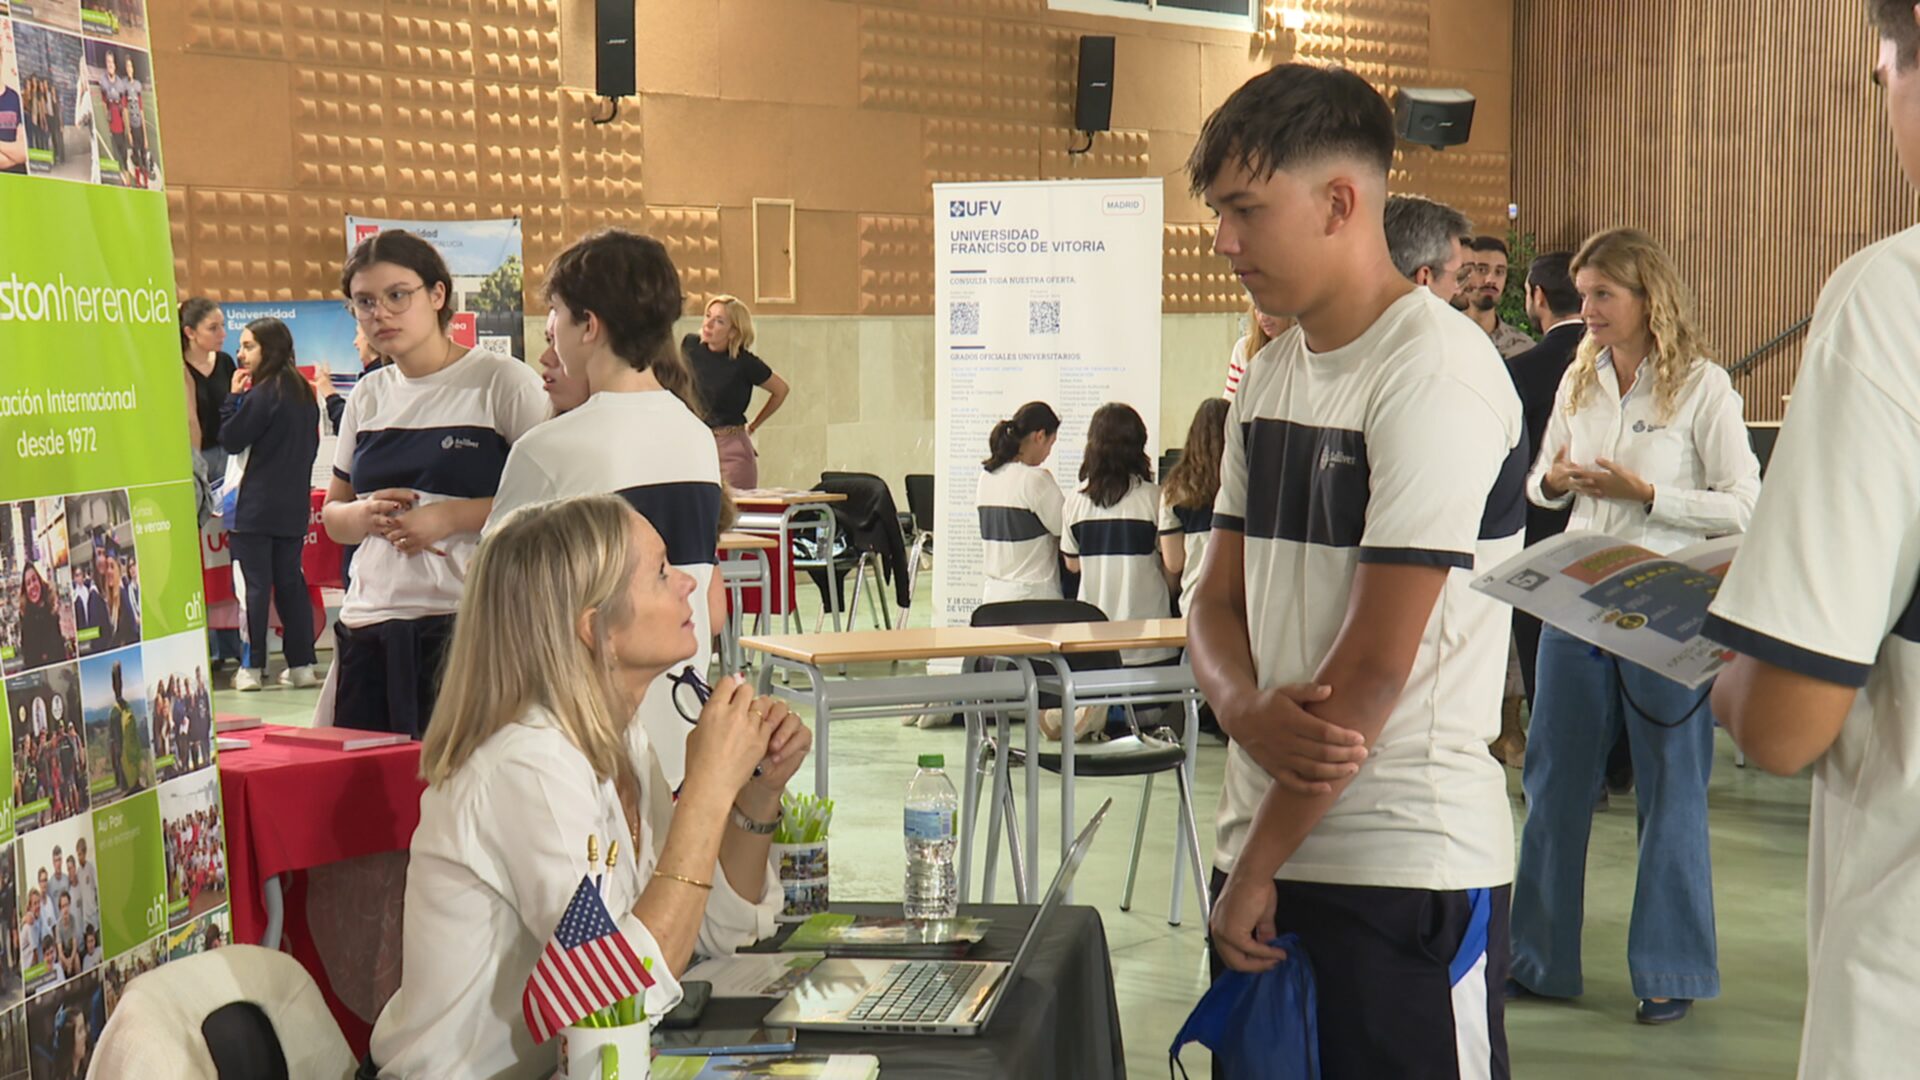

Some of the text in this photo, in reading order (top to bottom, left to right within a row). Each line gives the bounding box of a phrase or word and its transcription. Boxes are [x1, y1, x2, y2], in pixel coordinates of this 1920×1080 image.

[966, 200, 1002, 216] UFV
[1106, 200, 1140, 209] MADRID
[950, 228, 1039, 242] UNIVERSIDAD
[950, 239, 1106, 254] FRANCISCO DE VITORIA
[950, 277, 988, 285] CONSULTA
[1009, 276, 1044, 285] NUESTRA
[226, 308, 297, 320] Universidad
[950, 352, 1081, 361] GRADOS OFICIALES UNIVERSITARIOS
[0, 383, 137, 417] ación Internacional
[16, 426, 98, 458] desde 1972
[144, 519, 172, 533] verano
